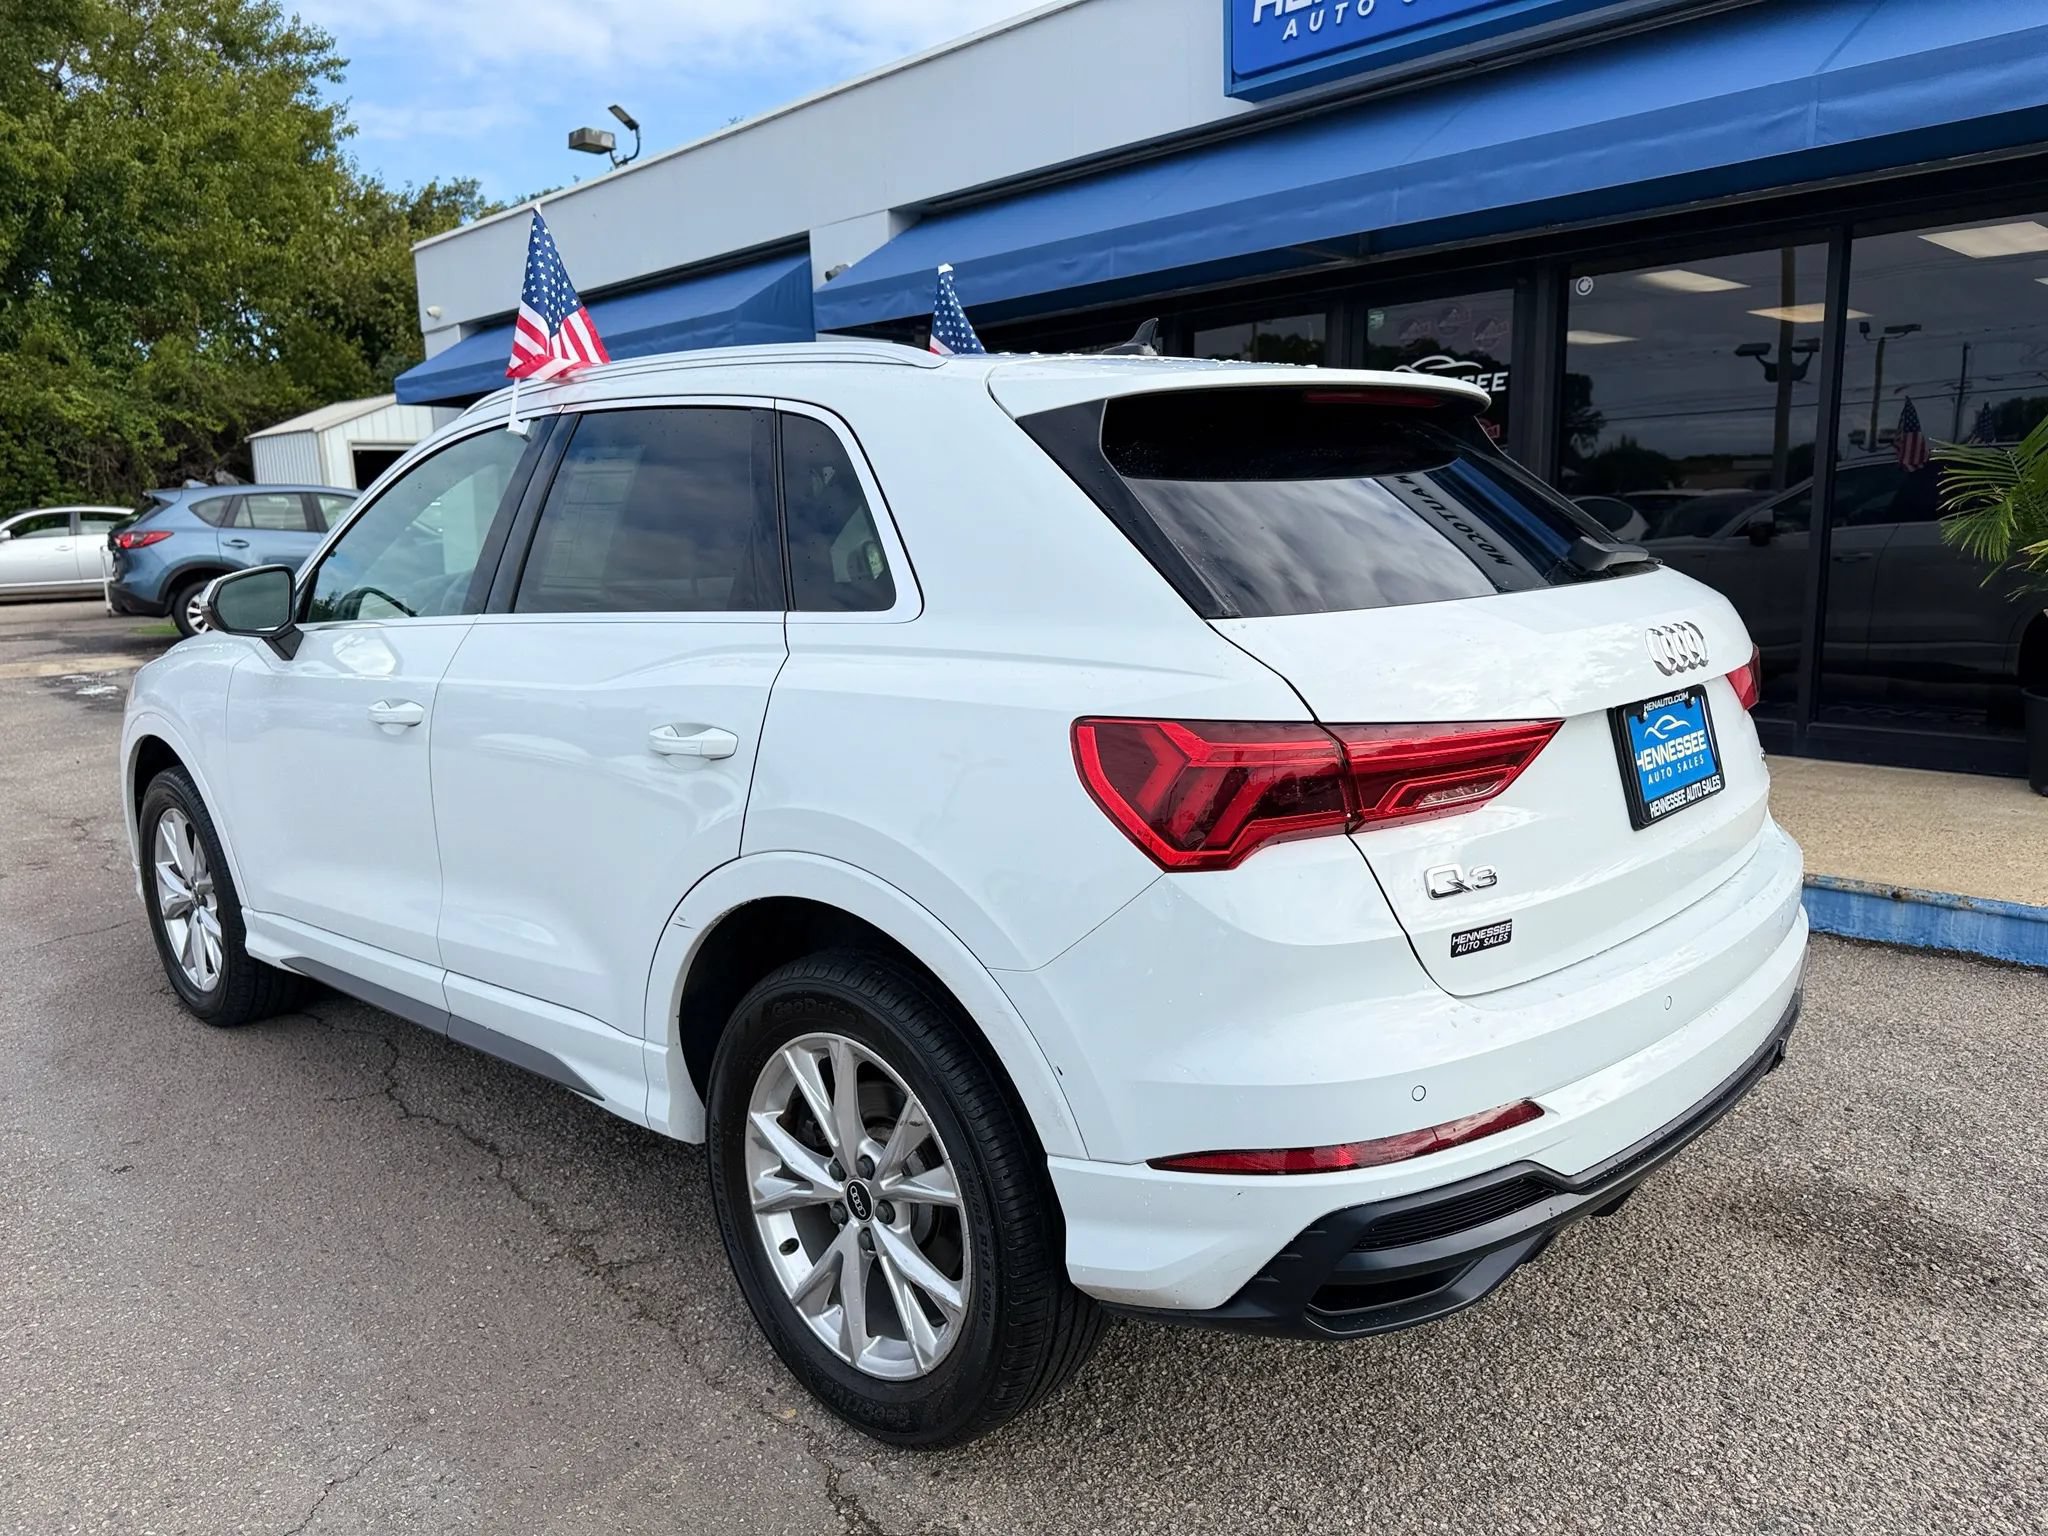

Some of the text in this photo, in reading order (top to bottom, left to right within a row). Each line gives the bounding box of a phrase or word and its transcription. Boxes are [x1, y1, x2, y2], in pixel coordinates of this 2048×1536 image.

[1282, 0, 1374, 40] AUTO
[1643, 691, 1690, 712] HENAUTO.COM
[1635, 729, 1708, 772] HENNESSEE
[1648, 754, 1705, 785] AUTO SALES
[1649, 774, 1722, 818] HENNESSEE AUTO SALES
[1424, 863, 1498, 900] Q3
[1452, 922, 1511, 953] HENNESSEE AUTO SALES
